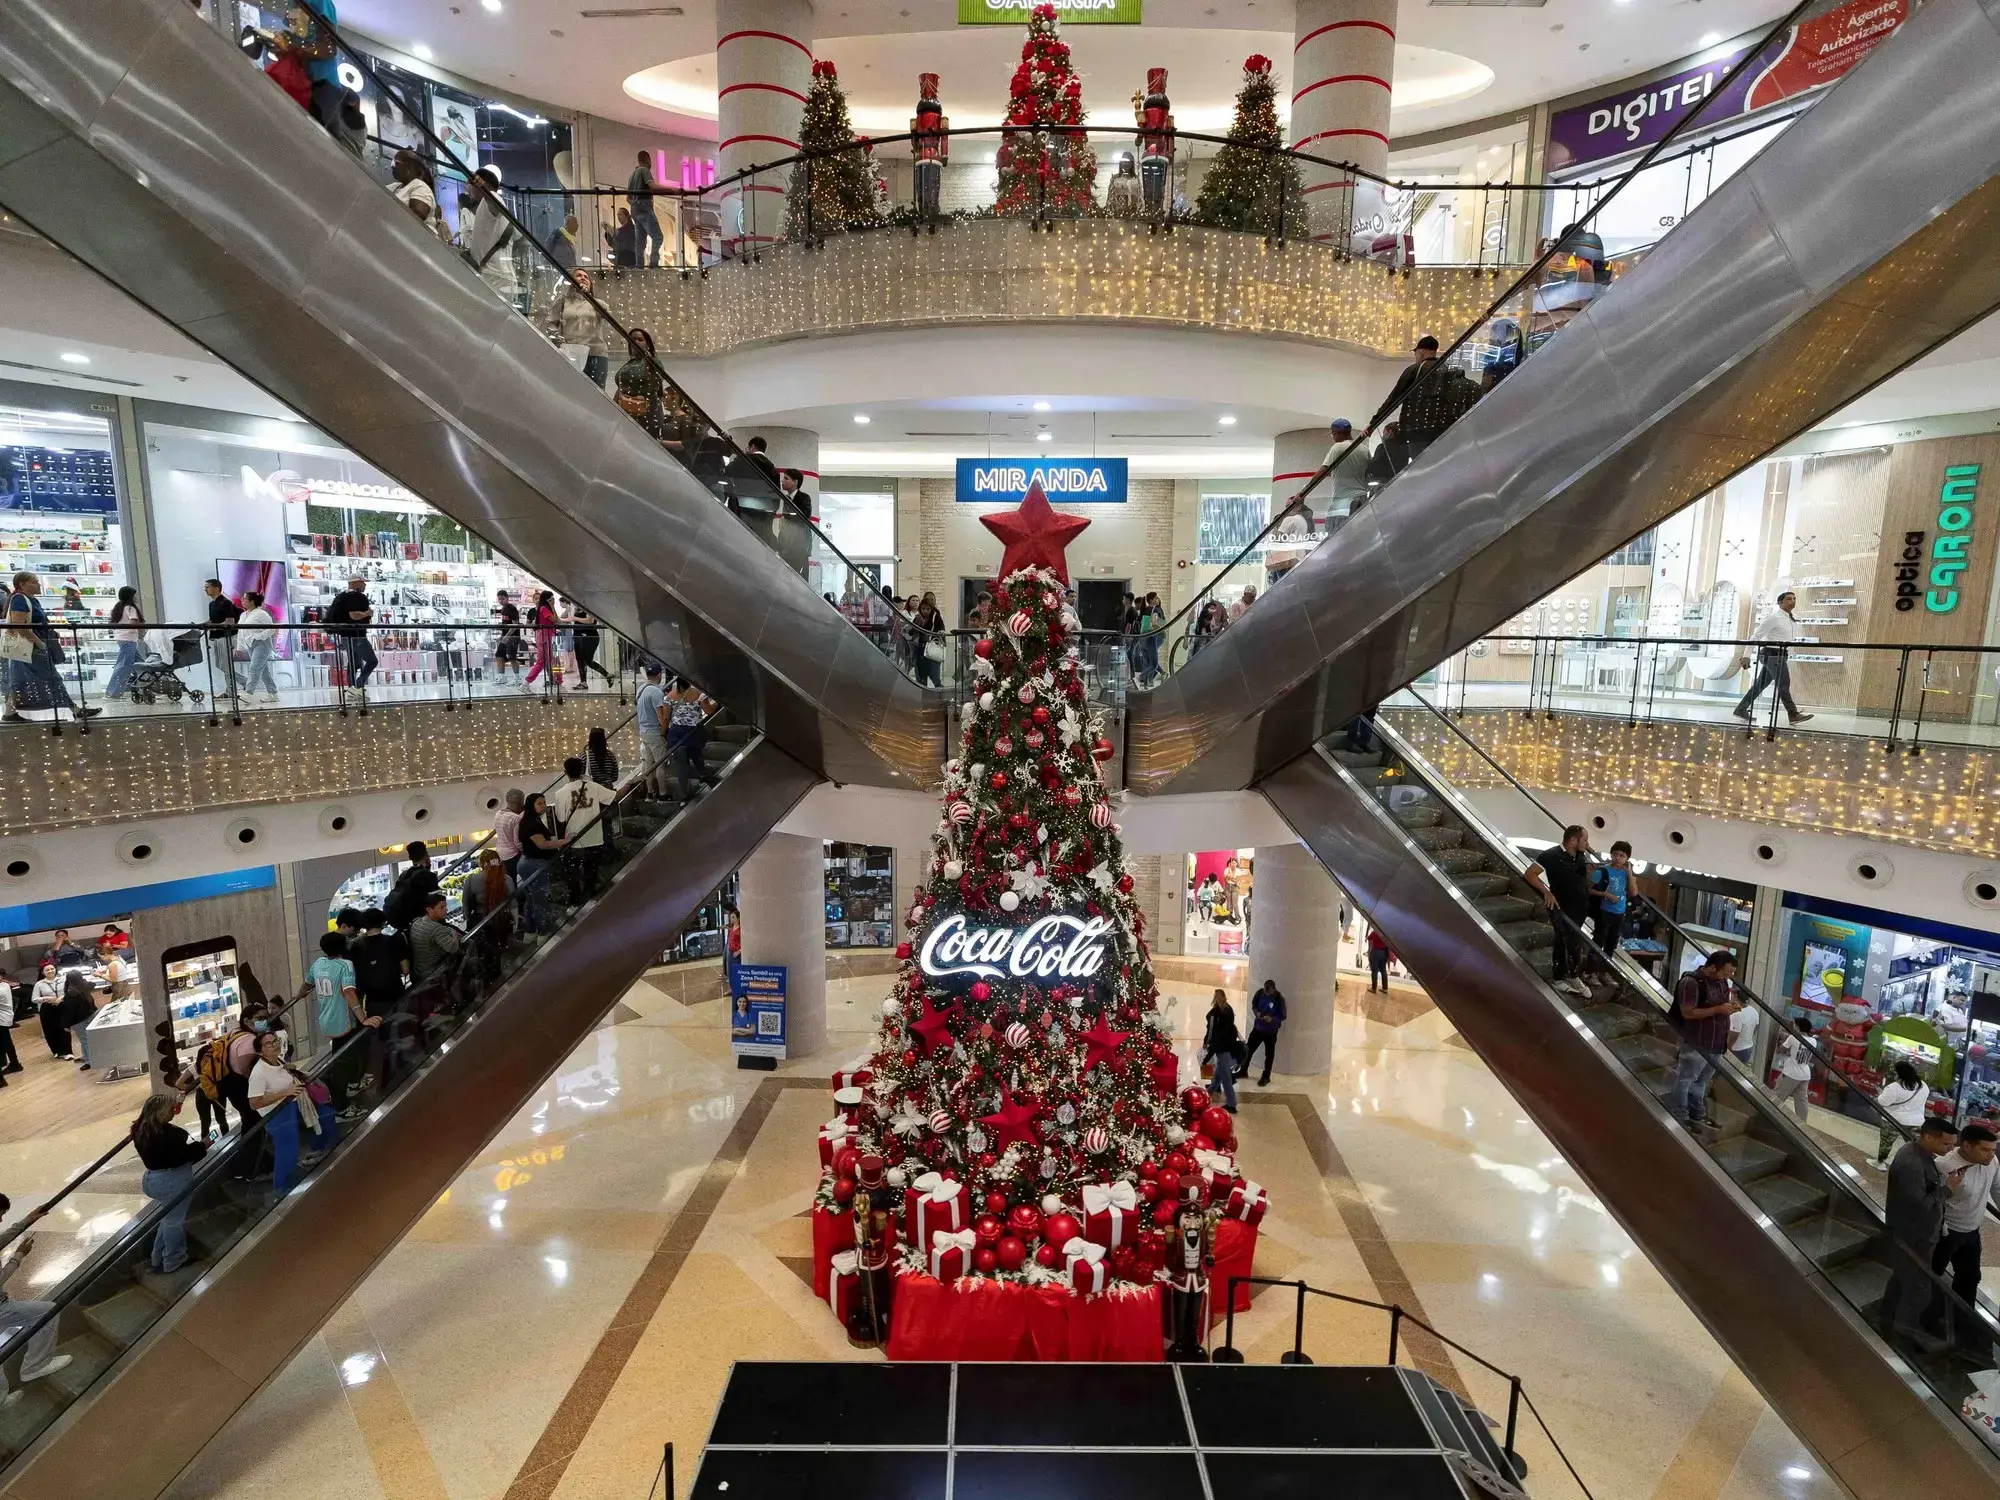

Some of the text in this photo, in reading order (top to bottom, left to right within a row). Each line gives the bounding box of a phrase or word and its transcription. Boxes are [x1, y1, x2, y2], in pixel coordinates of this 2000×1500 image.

[1847, 0, 1899, 28] Agente
[1819, 18, 1896, 55] Autorizado
[1817, 56, 1852, 74] Graham
[975, 468, 1107, 492] MIRANDA
